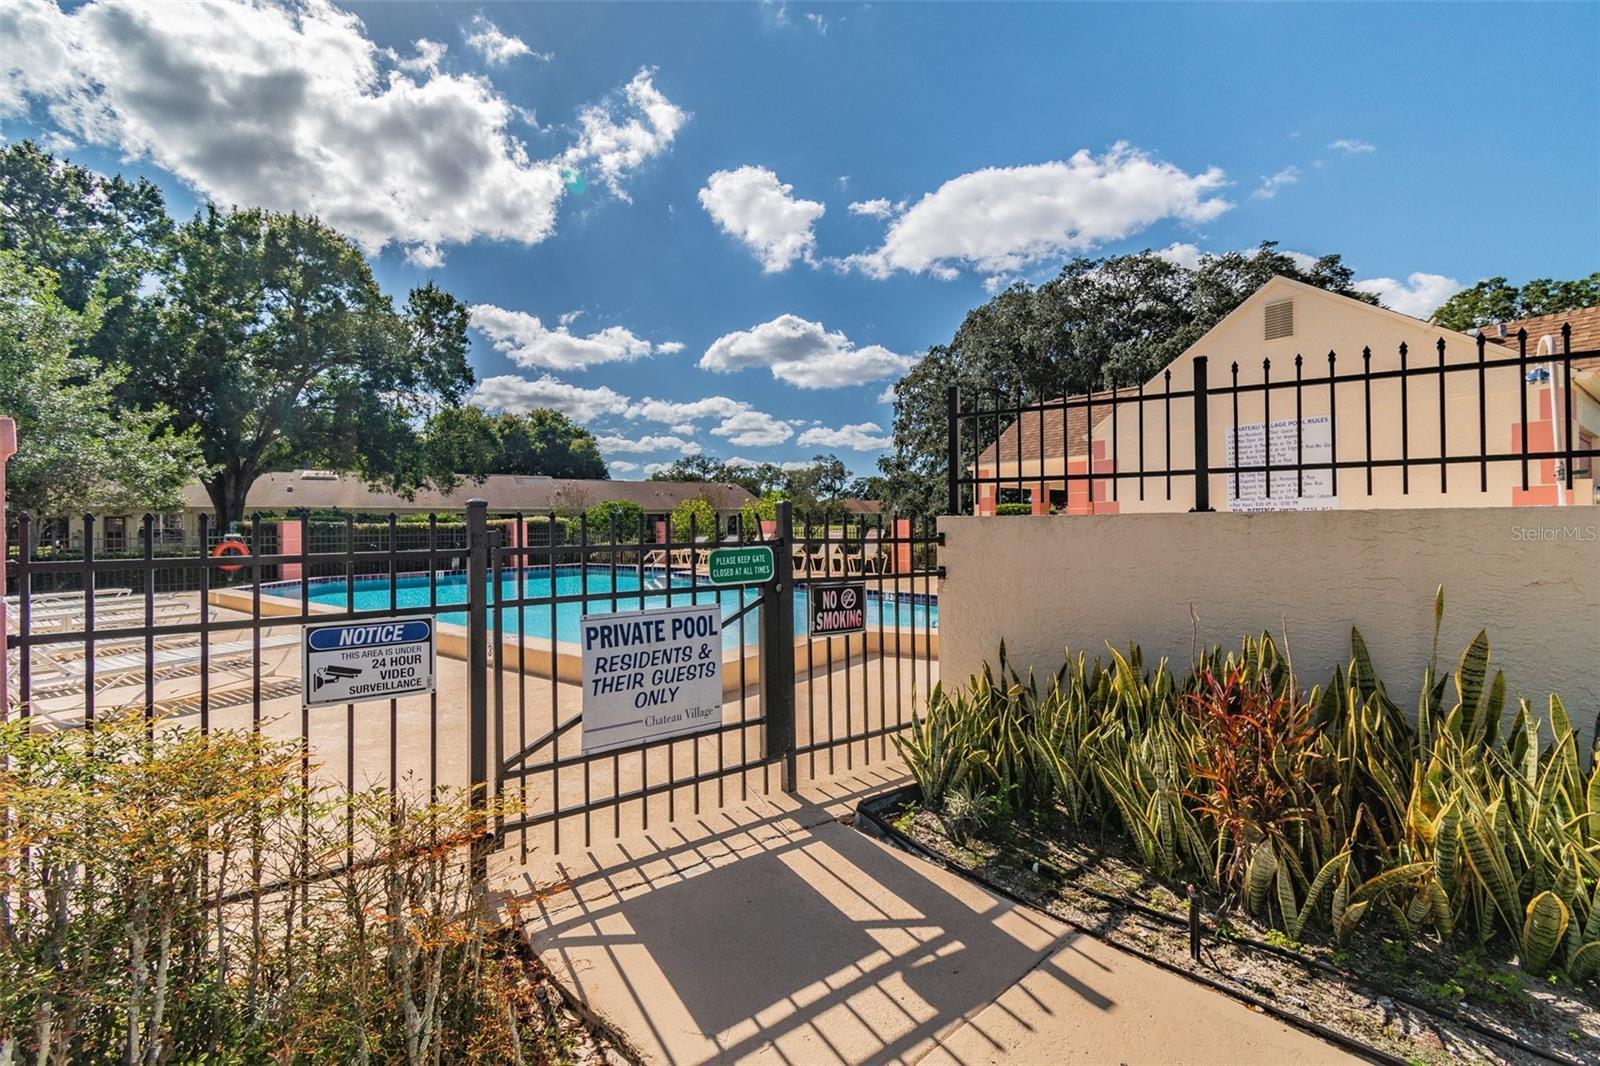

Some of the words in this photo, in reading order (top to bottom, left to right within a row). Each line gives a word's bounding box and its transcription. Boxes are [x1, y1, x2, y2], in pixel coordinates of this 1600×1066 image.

[1288, 418, 1305, 426] POL
[716, 556, 736, 565] PLEASE
[737, 555, 751, 564] KEEP
[752, 554, 766, 563] GATE
[713, 568, 734, 577] CLOSED
[743, 566, 753, 575] ALL
[754, 566, 770, 574] TIMES
[822, 590, 838, 610] NO
[816, 609, 862, 631] SMOKING
[339, 625, 404, 646] NOTICE
[586, 620, 665, 651] PRIVATE
[672, 615, 718, 640] POOL
[341, 652, 360, 660] THIS
[361, 649, 384, 658] AREA
[385, 647, 393, 655] IS
[396, 645, 422, 654] UNDER
[372, 658, 386, 669] 24
[390, 654, 422, 667] HOUR
[594, 646, 693, 675] RESIDENTS
[698, 643, 712, 660] &
[380, 666, 415, 680] VIDEO
[592, 672, 645, 696] THEIR
[652, 662, 716, 686] GUESTS
[349, 678, 422, 695] SURVEILLANCE
[635, 686, 680, 709] ONLY
[644, 711, 682, 727] Chateau
[685, 706, 714, 720] Village
